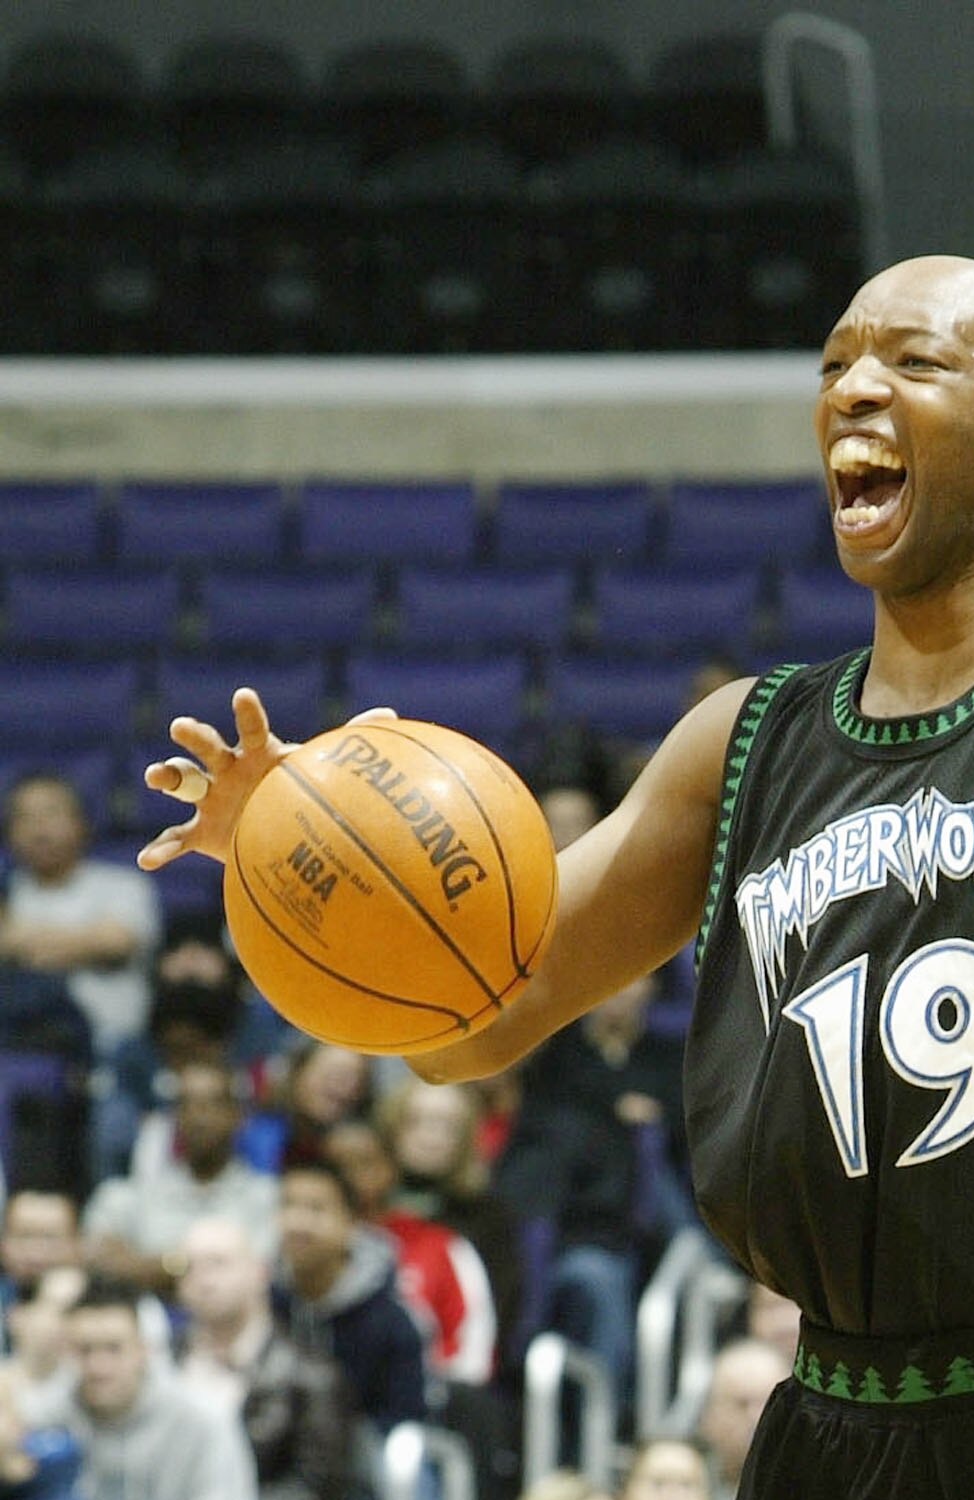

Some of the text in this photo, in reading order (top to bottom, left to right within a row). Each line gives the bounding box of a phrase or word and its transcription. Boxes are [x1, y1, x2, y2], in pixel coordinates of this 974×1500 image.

[323, 734, 487, 902] SPALDING
[287, 840, 338, 904] NBA
[351, 873, 374, 897] Ball
